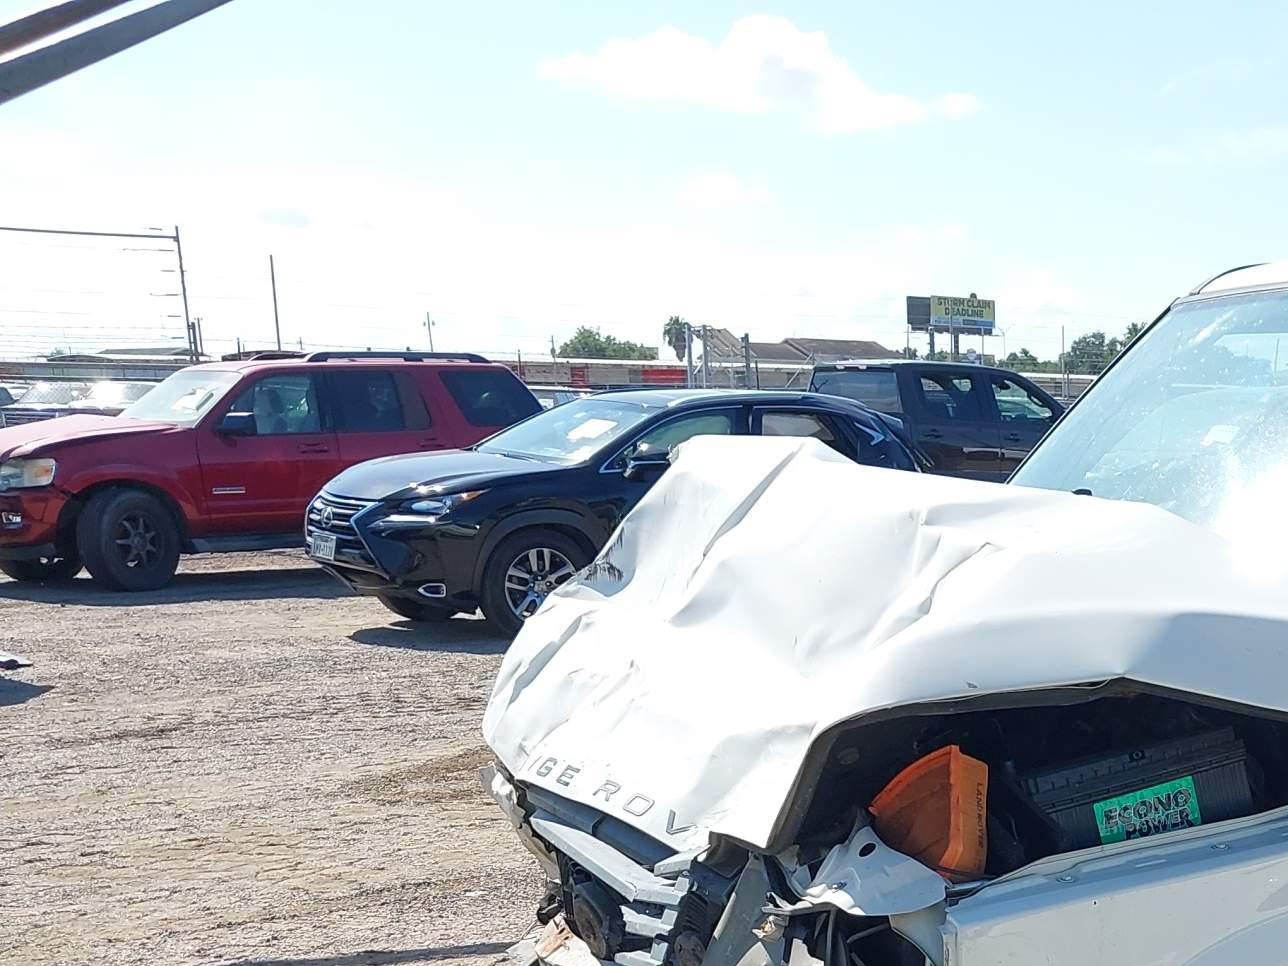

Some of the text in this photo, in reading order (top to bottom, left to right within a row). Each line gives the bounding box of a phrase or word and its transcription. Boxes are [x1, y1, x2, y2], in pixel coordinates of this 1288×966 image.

[944, 307, 985, 318] DEADLINE
[966, 299, 991, 309] CLAIM
[975, 782, 984, 849] LAND ROVER
[1102, 787, 1192, 830] ECONO
[1125, 807, 1196, 840] POWER
